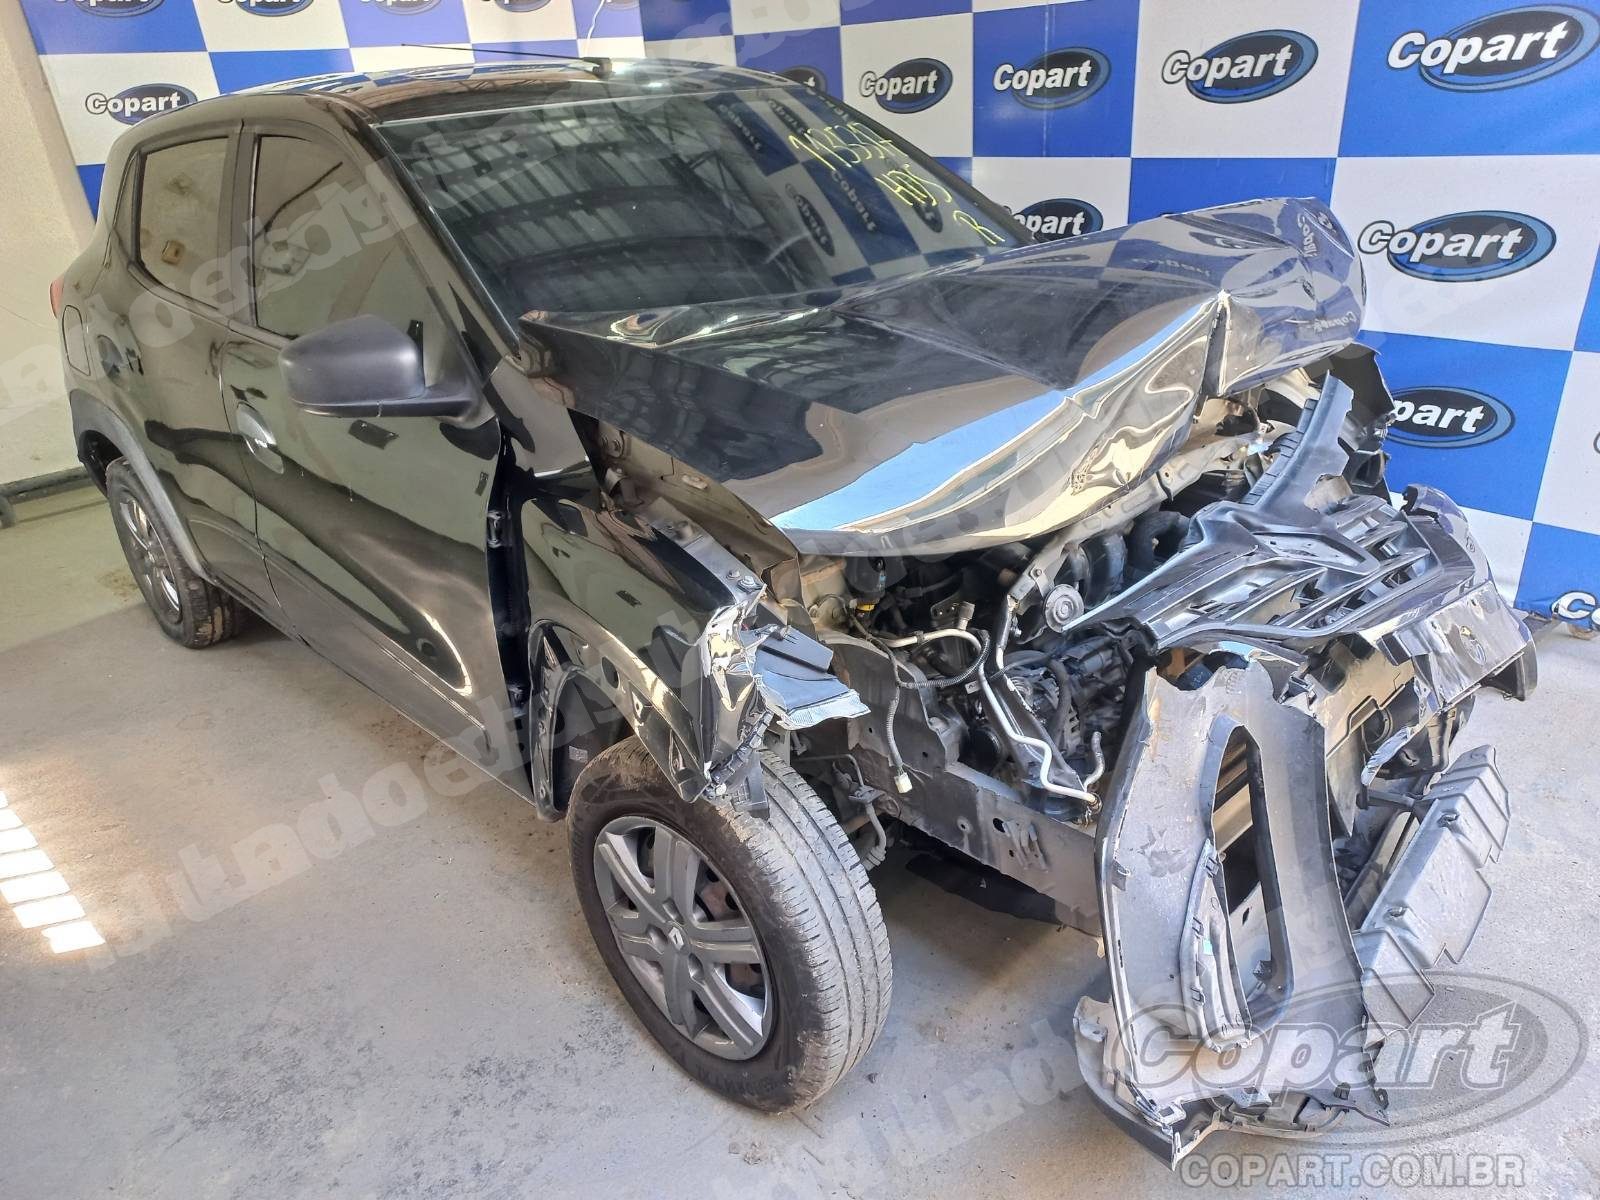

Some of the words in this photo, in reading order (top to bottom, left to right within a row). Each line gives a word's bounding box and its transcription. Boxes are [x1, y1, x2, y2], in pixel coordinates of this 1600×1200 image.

[1387, 20, 1569, 74] Copart
[993, 60, 1092, 96] Copart
[1162, 44, 1293, 87] Copart
[860, 70, 938, 100] Copart
[85, 91, 180, 117] Copart
[1012, 210, 1085, 240] part
[1358, 220, 1523, 263] Copart
[1391, 399, 1485, 433] part
